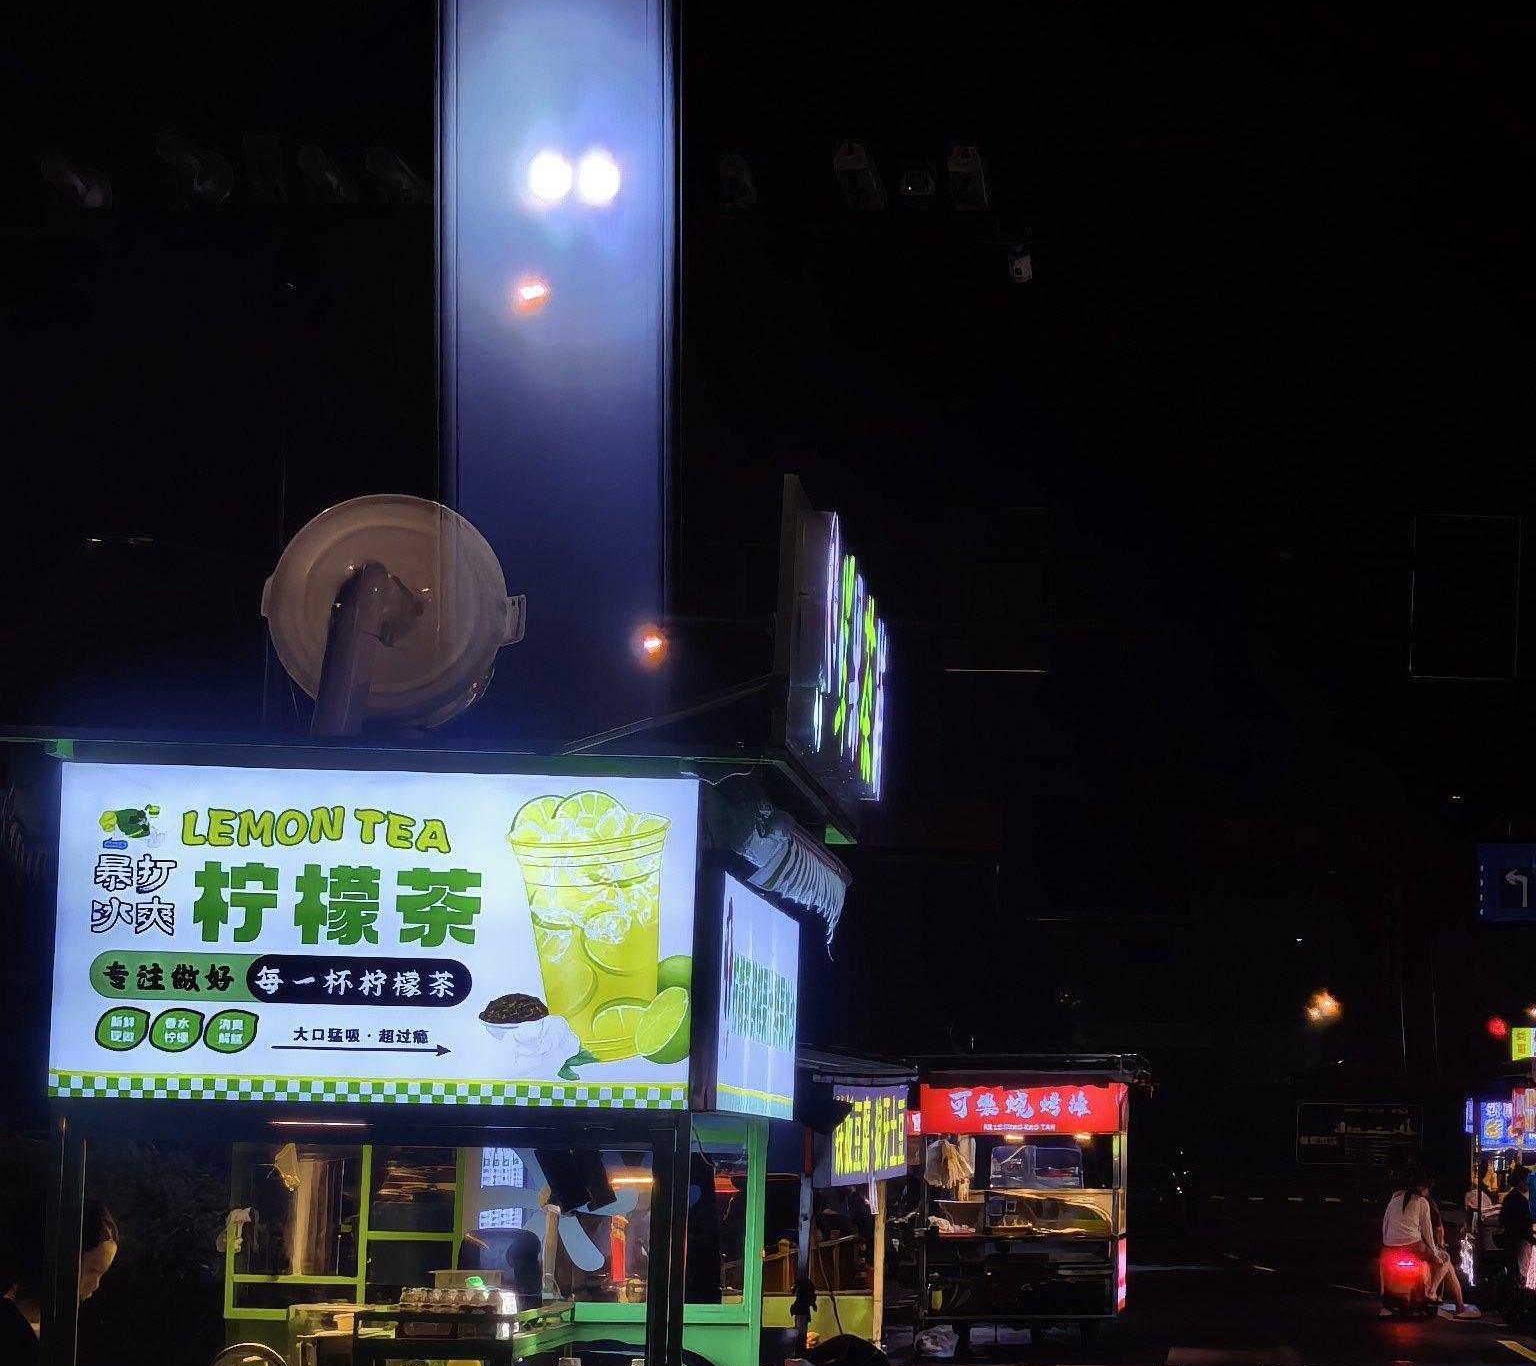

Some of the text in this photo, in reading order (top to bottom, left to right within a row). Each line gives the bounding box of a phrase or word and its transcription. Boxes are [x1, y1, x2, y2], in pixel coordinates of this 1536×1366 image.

[181, 806, 452, 854] LEMON TEA
[93, 853, 177, 894] 暴打
[193, 861, 483, 948] 柠檬茶
[102, 961, 455, 998] 专注做好 每一杯柠檬茶
